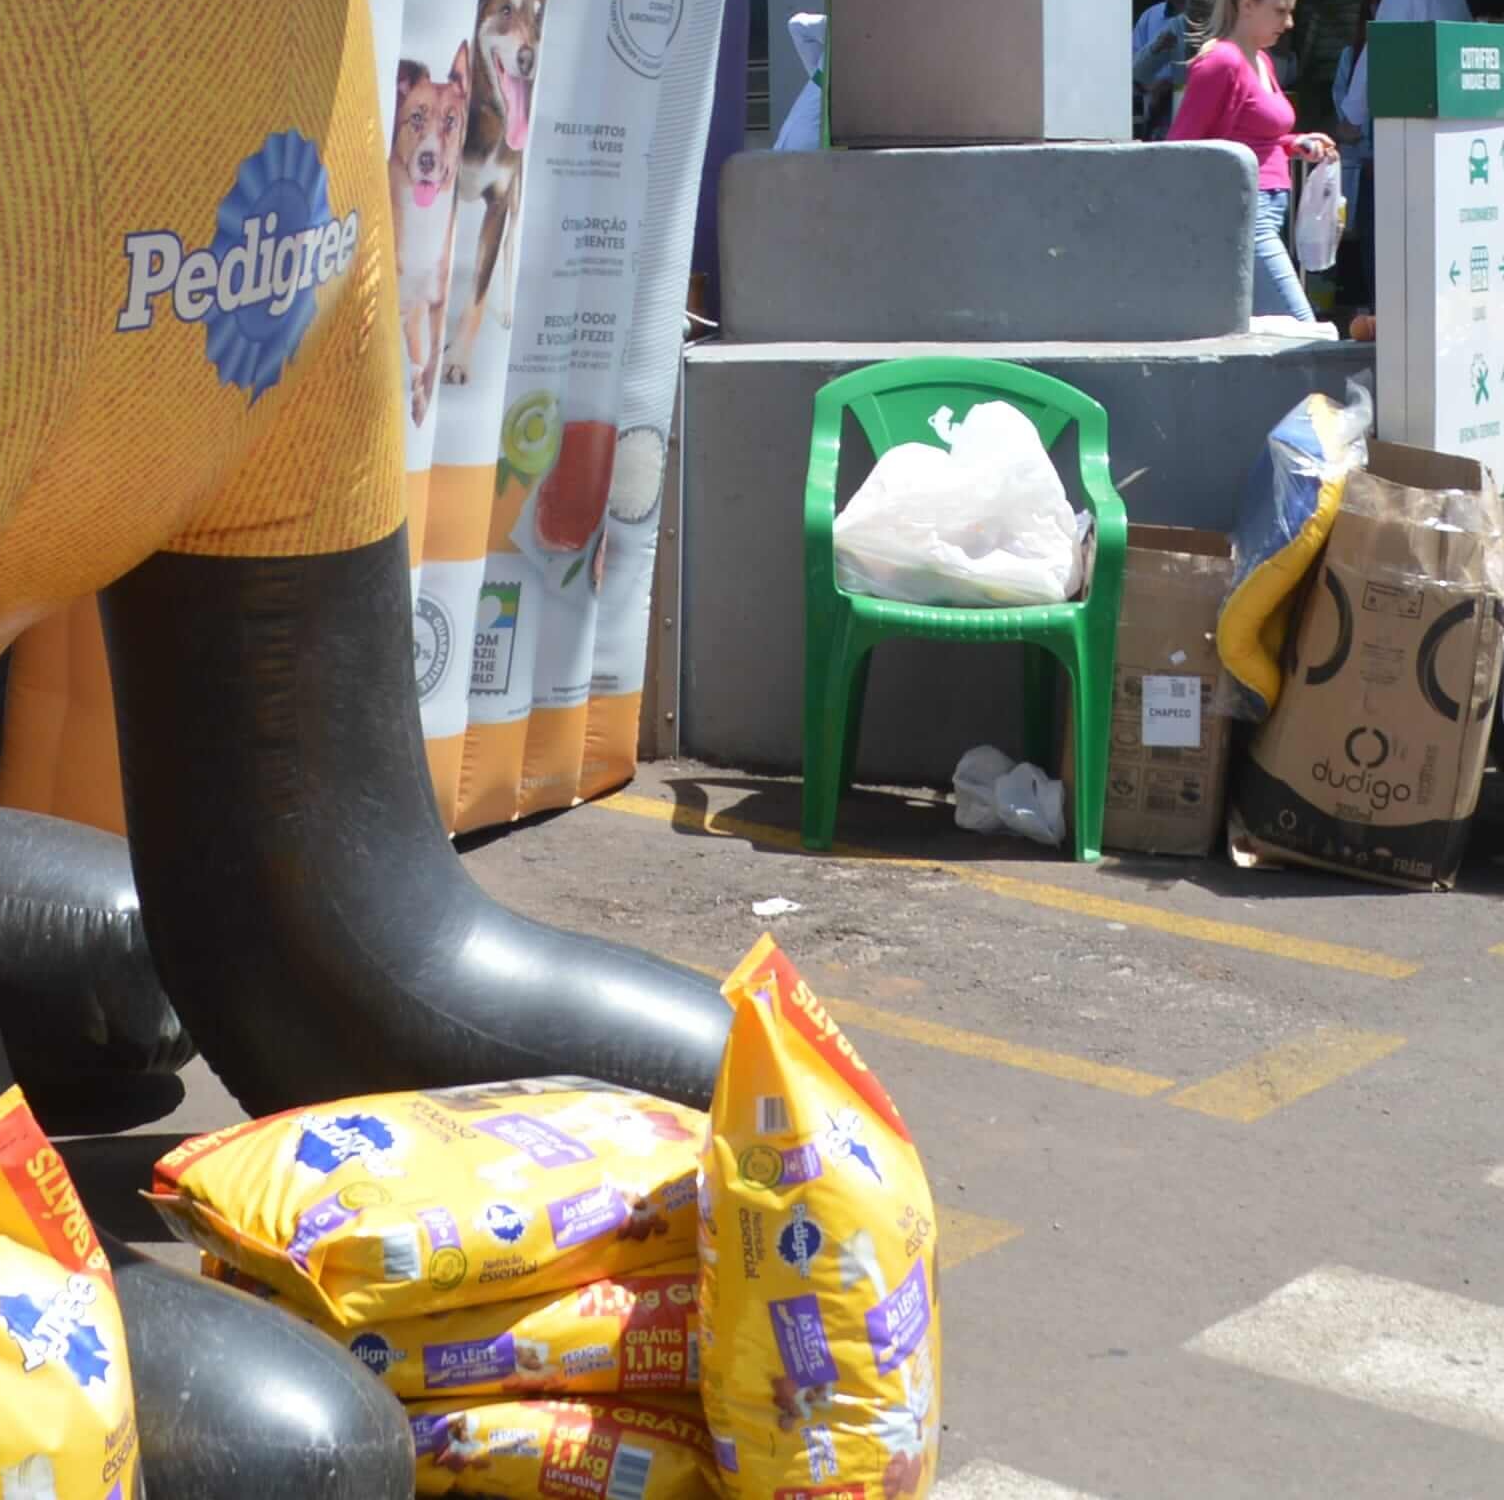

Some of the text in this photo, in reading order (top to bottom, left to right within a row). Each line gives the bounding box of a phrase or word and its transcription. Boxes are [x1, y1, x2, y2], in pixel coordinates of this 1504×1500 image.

[115, 209, 359, 332] Pedigree
[1311, 758, 1411, 811] dudigo
[25, 1146, 99, 1265] GRÁTIS
[791, 1203, 811, 1279] Pedigree
[478, 1260, 538, 1284] essencial
[625, 1326, 683, 1346] GRÁTIS
[554, 1425, 612, 1451] GRÁTIS
